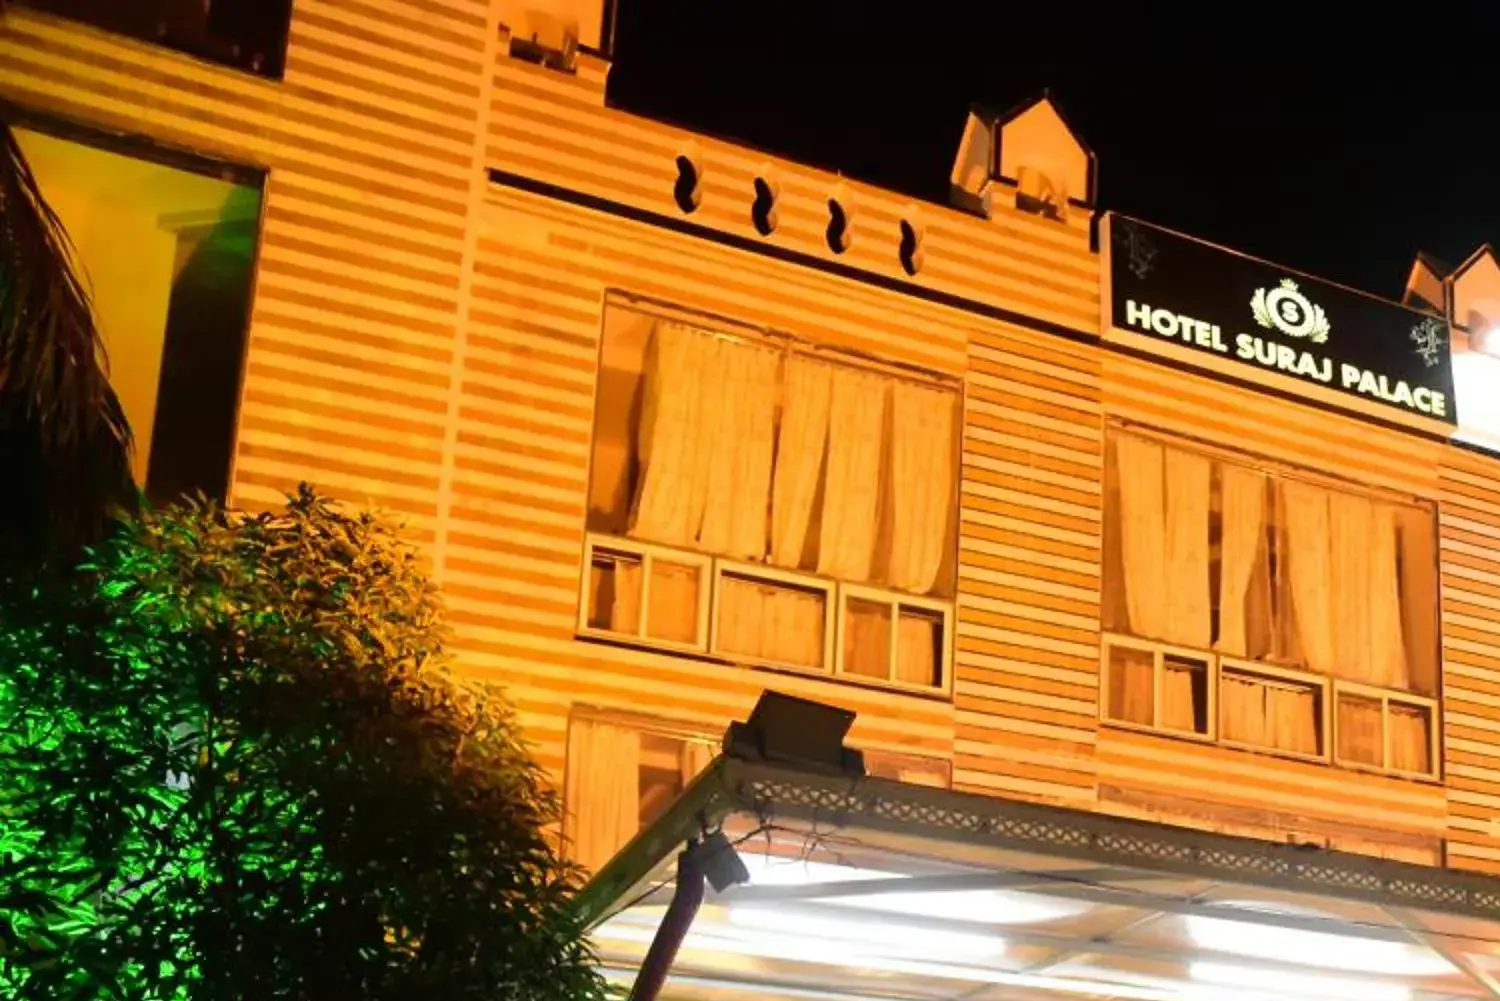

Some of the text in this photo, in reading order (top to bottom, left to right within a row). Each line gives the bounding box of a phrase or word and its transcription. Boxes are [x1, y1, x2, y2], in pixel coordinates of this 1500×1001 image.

[1282, 301, 1299, 323] S
[1126, 300, 1446, 416] HOTEL SURAJ PALACE
